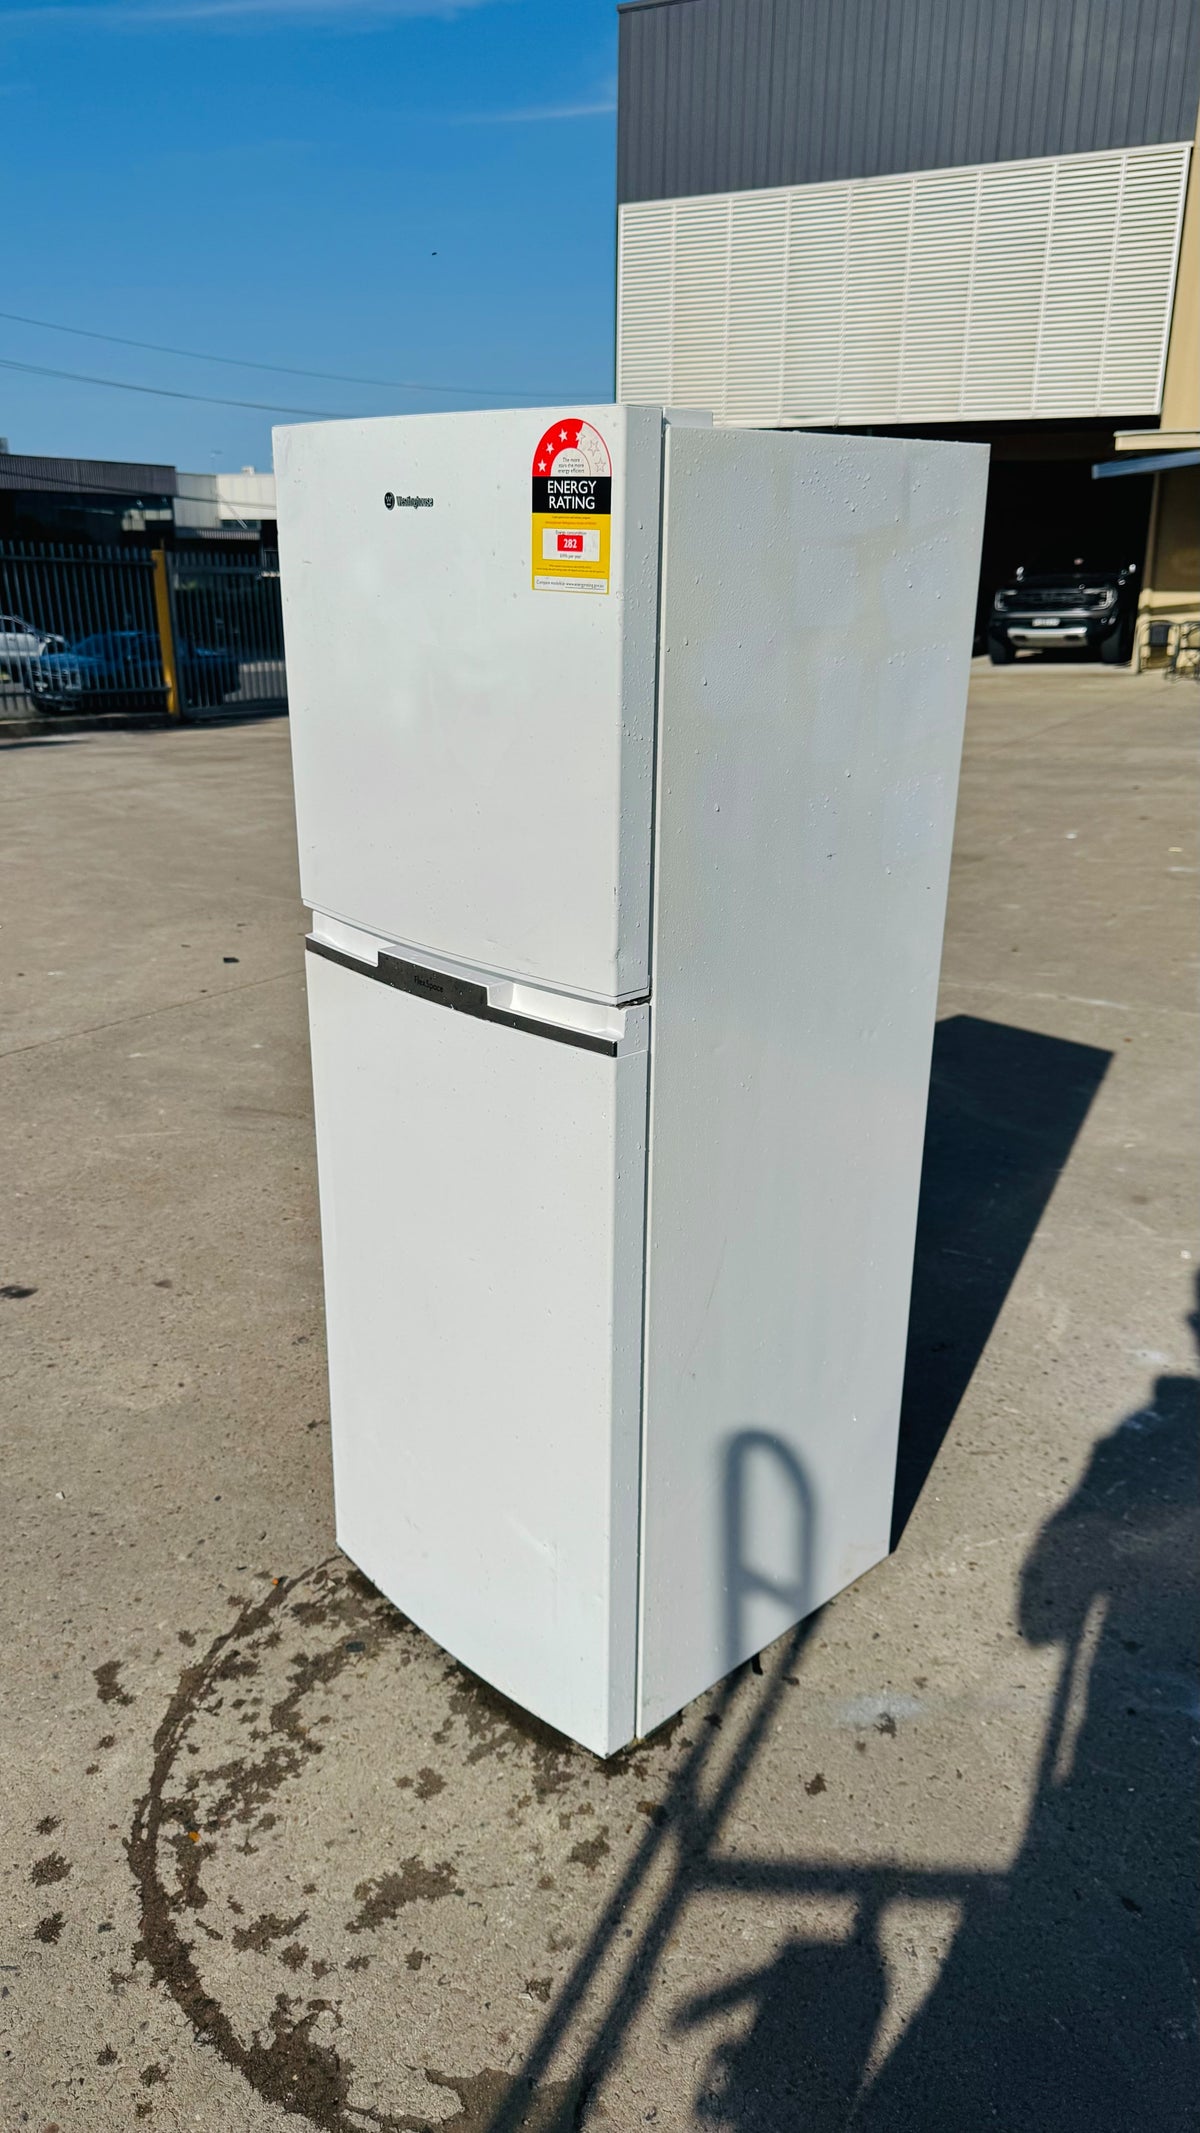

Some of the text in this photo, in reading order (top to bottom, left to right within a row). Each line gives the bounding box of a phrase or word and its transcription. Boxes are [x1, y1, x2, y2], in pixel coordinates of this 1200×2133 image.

[548, 480, 596, 494] ENERGY
[396, 496, 434, 510] Westinghouse
[549, 496, 595, 510] RATING
[564, 538, 577, 548] 282
